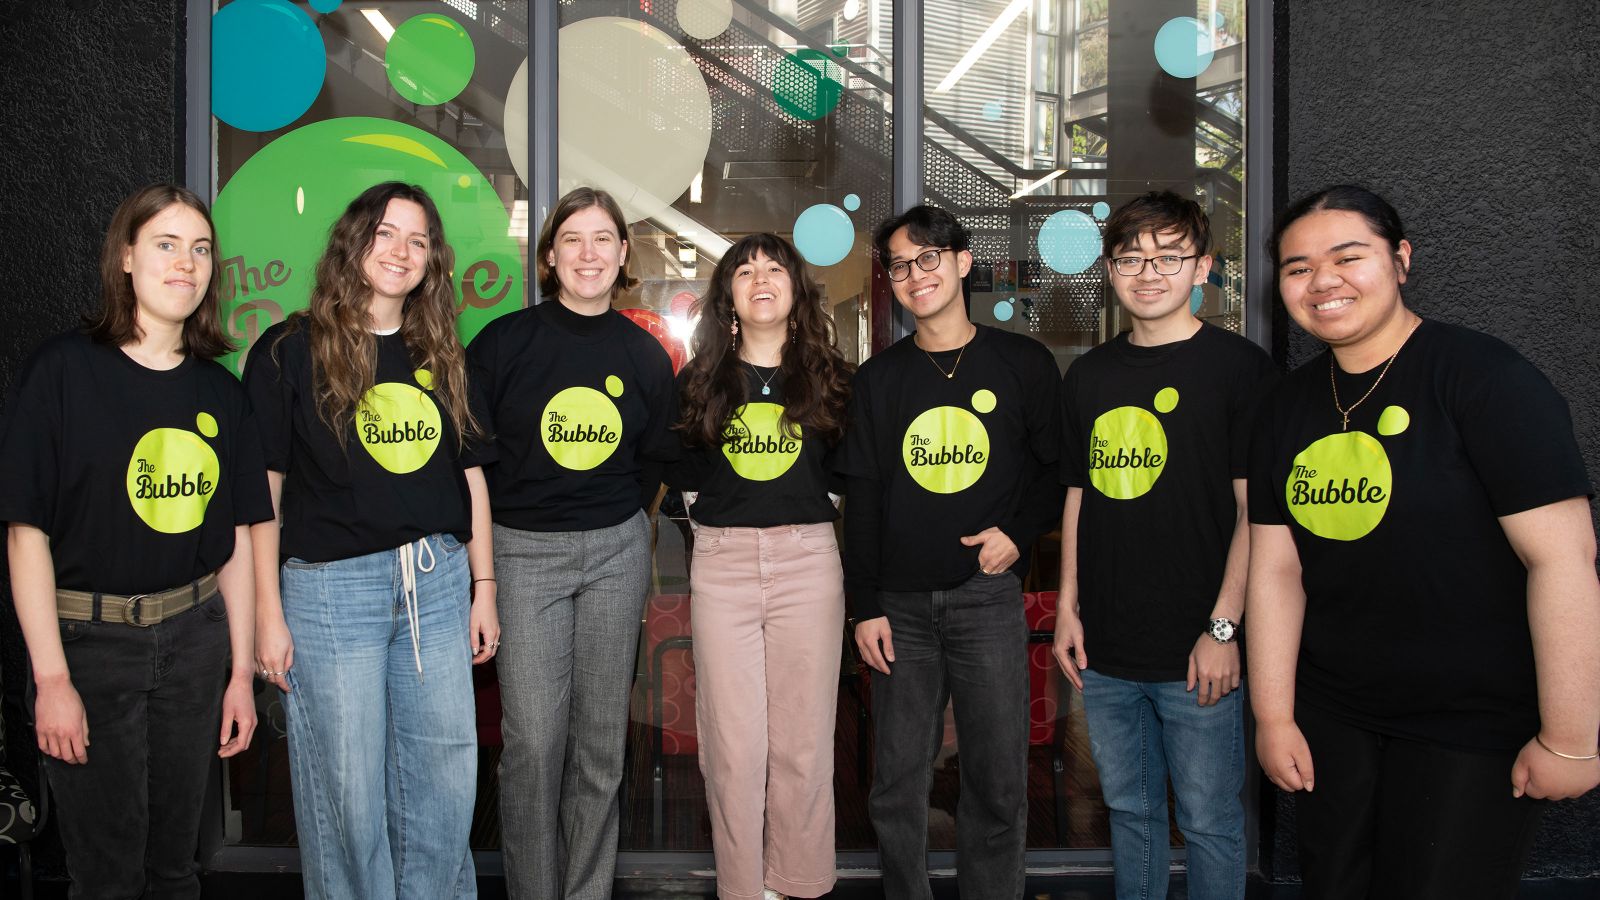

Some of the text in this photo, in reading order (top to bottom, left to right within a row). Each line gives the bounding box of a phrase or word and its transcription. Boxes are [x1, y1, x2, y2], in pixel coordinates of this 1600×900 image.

[221, 255, 292, 300] The
[361, 410, 381, 422] The
[548, 411, 568, 422] The
[363, 420, 438, 444] Bubble
[548, 423, 618, 444] Bubble
[910, 434, 931, 446] The
[728, 435, 798, 454] Bubble
[137, 459, 156, 473] The
[910, 444, 985, 467] Bubble
[1090, 446, 1163, 469] Bubble
[1295, 465, 1318, 479] The
[136, 472, 213, 499] Bubble
[1291, 477, 1386, 505] Bubble
